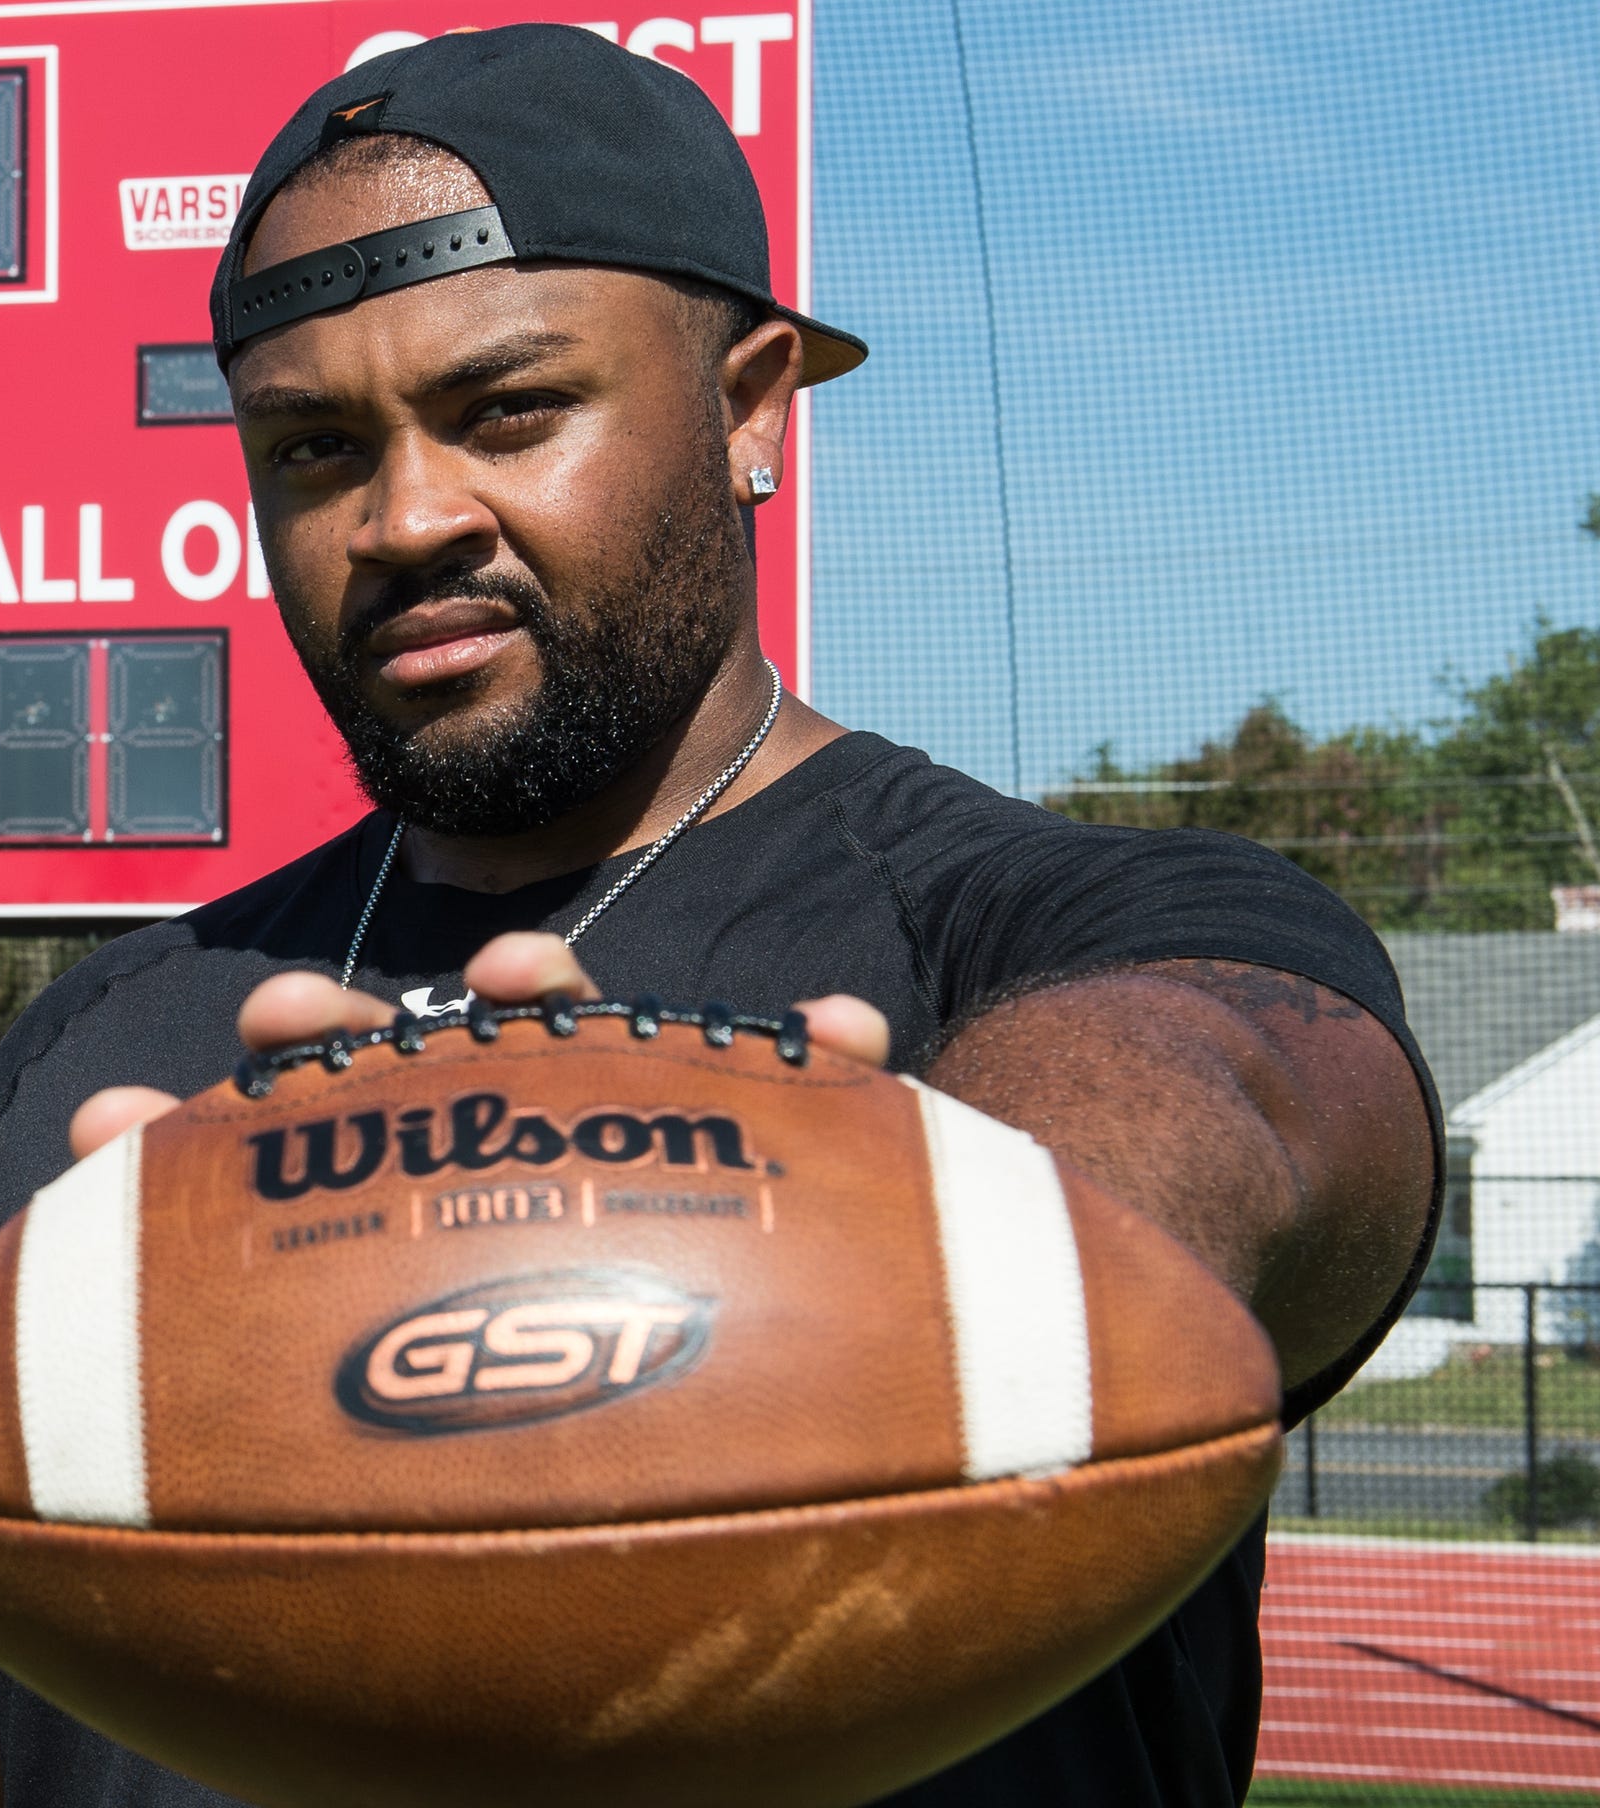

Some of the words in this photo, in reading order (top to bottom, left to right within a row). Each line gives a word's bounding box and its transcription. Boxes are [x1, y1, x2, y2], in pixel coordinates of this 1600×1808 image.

[130, 184, 241, 223] VARSI
[134, 226, 232, 243] SCOREBO
[247, 1093, 756, 1201] Wilson
[435, 1182, 565, 1230] 1003
[366, 1302, 692, 1400] GST
